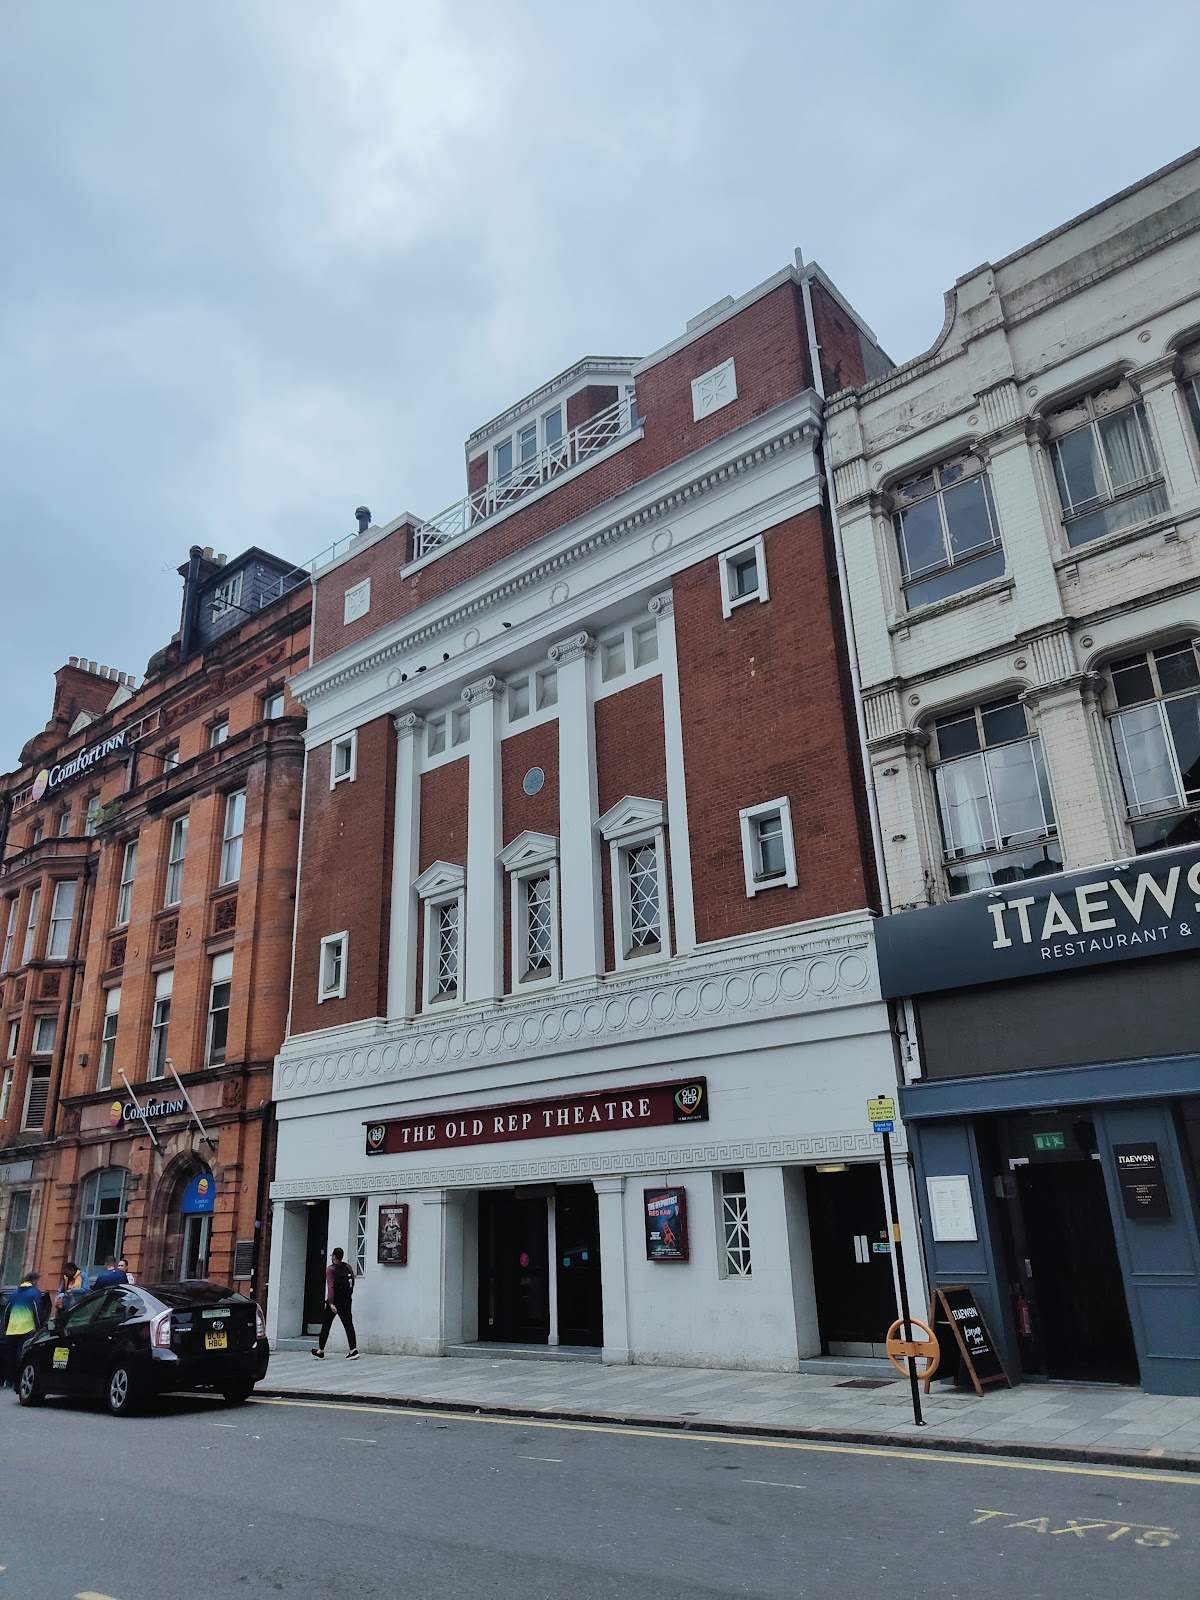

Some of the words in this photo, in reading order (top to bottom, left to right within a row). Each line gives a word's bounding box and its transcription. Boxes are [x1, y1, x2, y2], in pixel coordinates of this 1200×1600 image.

[48, 744, 103, 787] Comfort
[101, 731, 126, 757] INN
[1040, 925, 1169, 960] RESTAURANT
[1179, 922, 1193, 937] &
[682, 1088, 697, 1097] OLD
[682, 1096, 698, 1105] REP
[122, 1098, 166, 1121] Comfort
[165, 1099, 185, 1113] INN
[401, 1124, 437, 1145] THE
[445, 1118, 484, 1139] OLD
[493, 1113, 532, 1134] REP
[542, 1098, 652, 1128] THEATRE
[1118, 1154, 1155, 1164] ITAEWON
[648, 1209, 660, 1217] RED
[969, 1508, 1180, 1548] TAXIS
